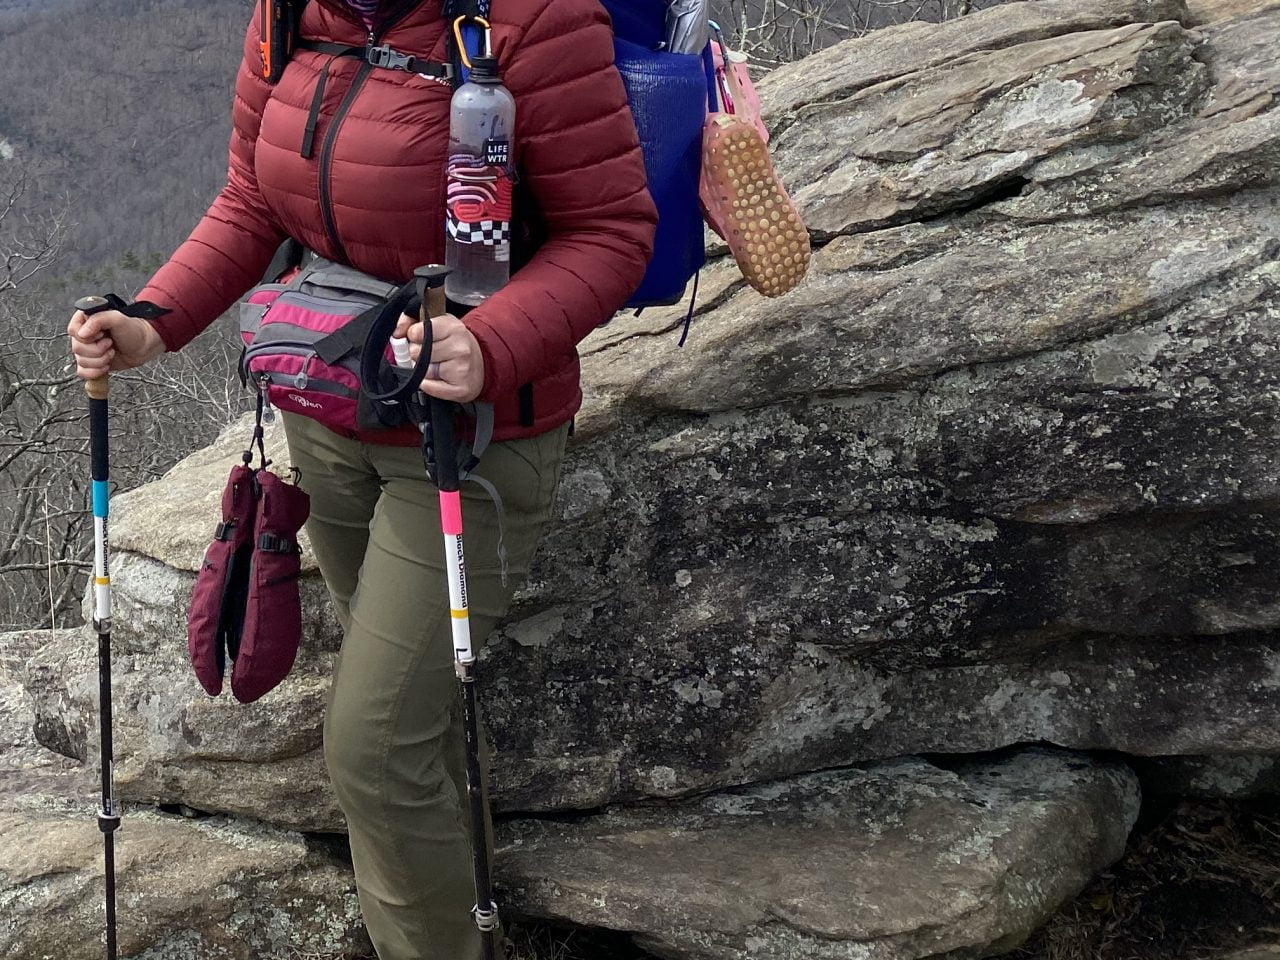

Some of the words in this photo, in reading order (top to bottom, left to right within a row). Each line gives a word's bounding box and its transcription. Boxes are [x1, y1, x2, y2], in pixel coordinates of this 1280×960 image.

[488, 145, 508, 153] LIFE
[487, 155, 507, 163] WTR
[458, 563, 468, 608] Diamond
